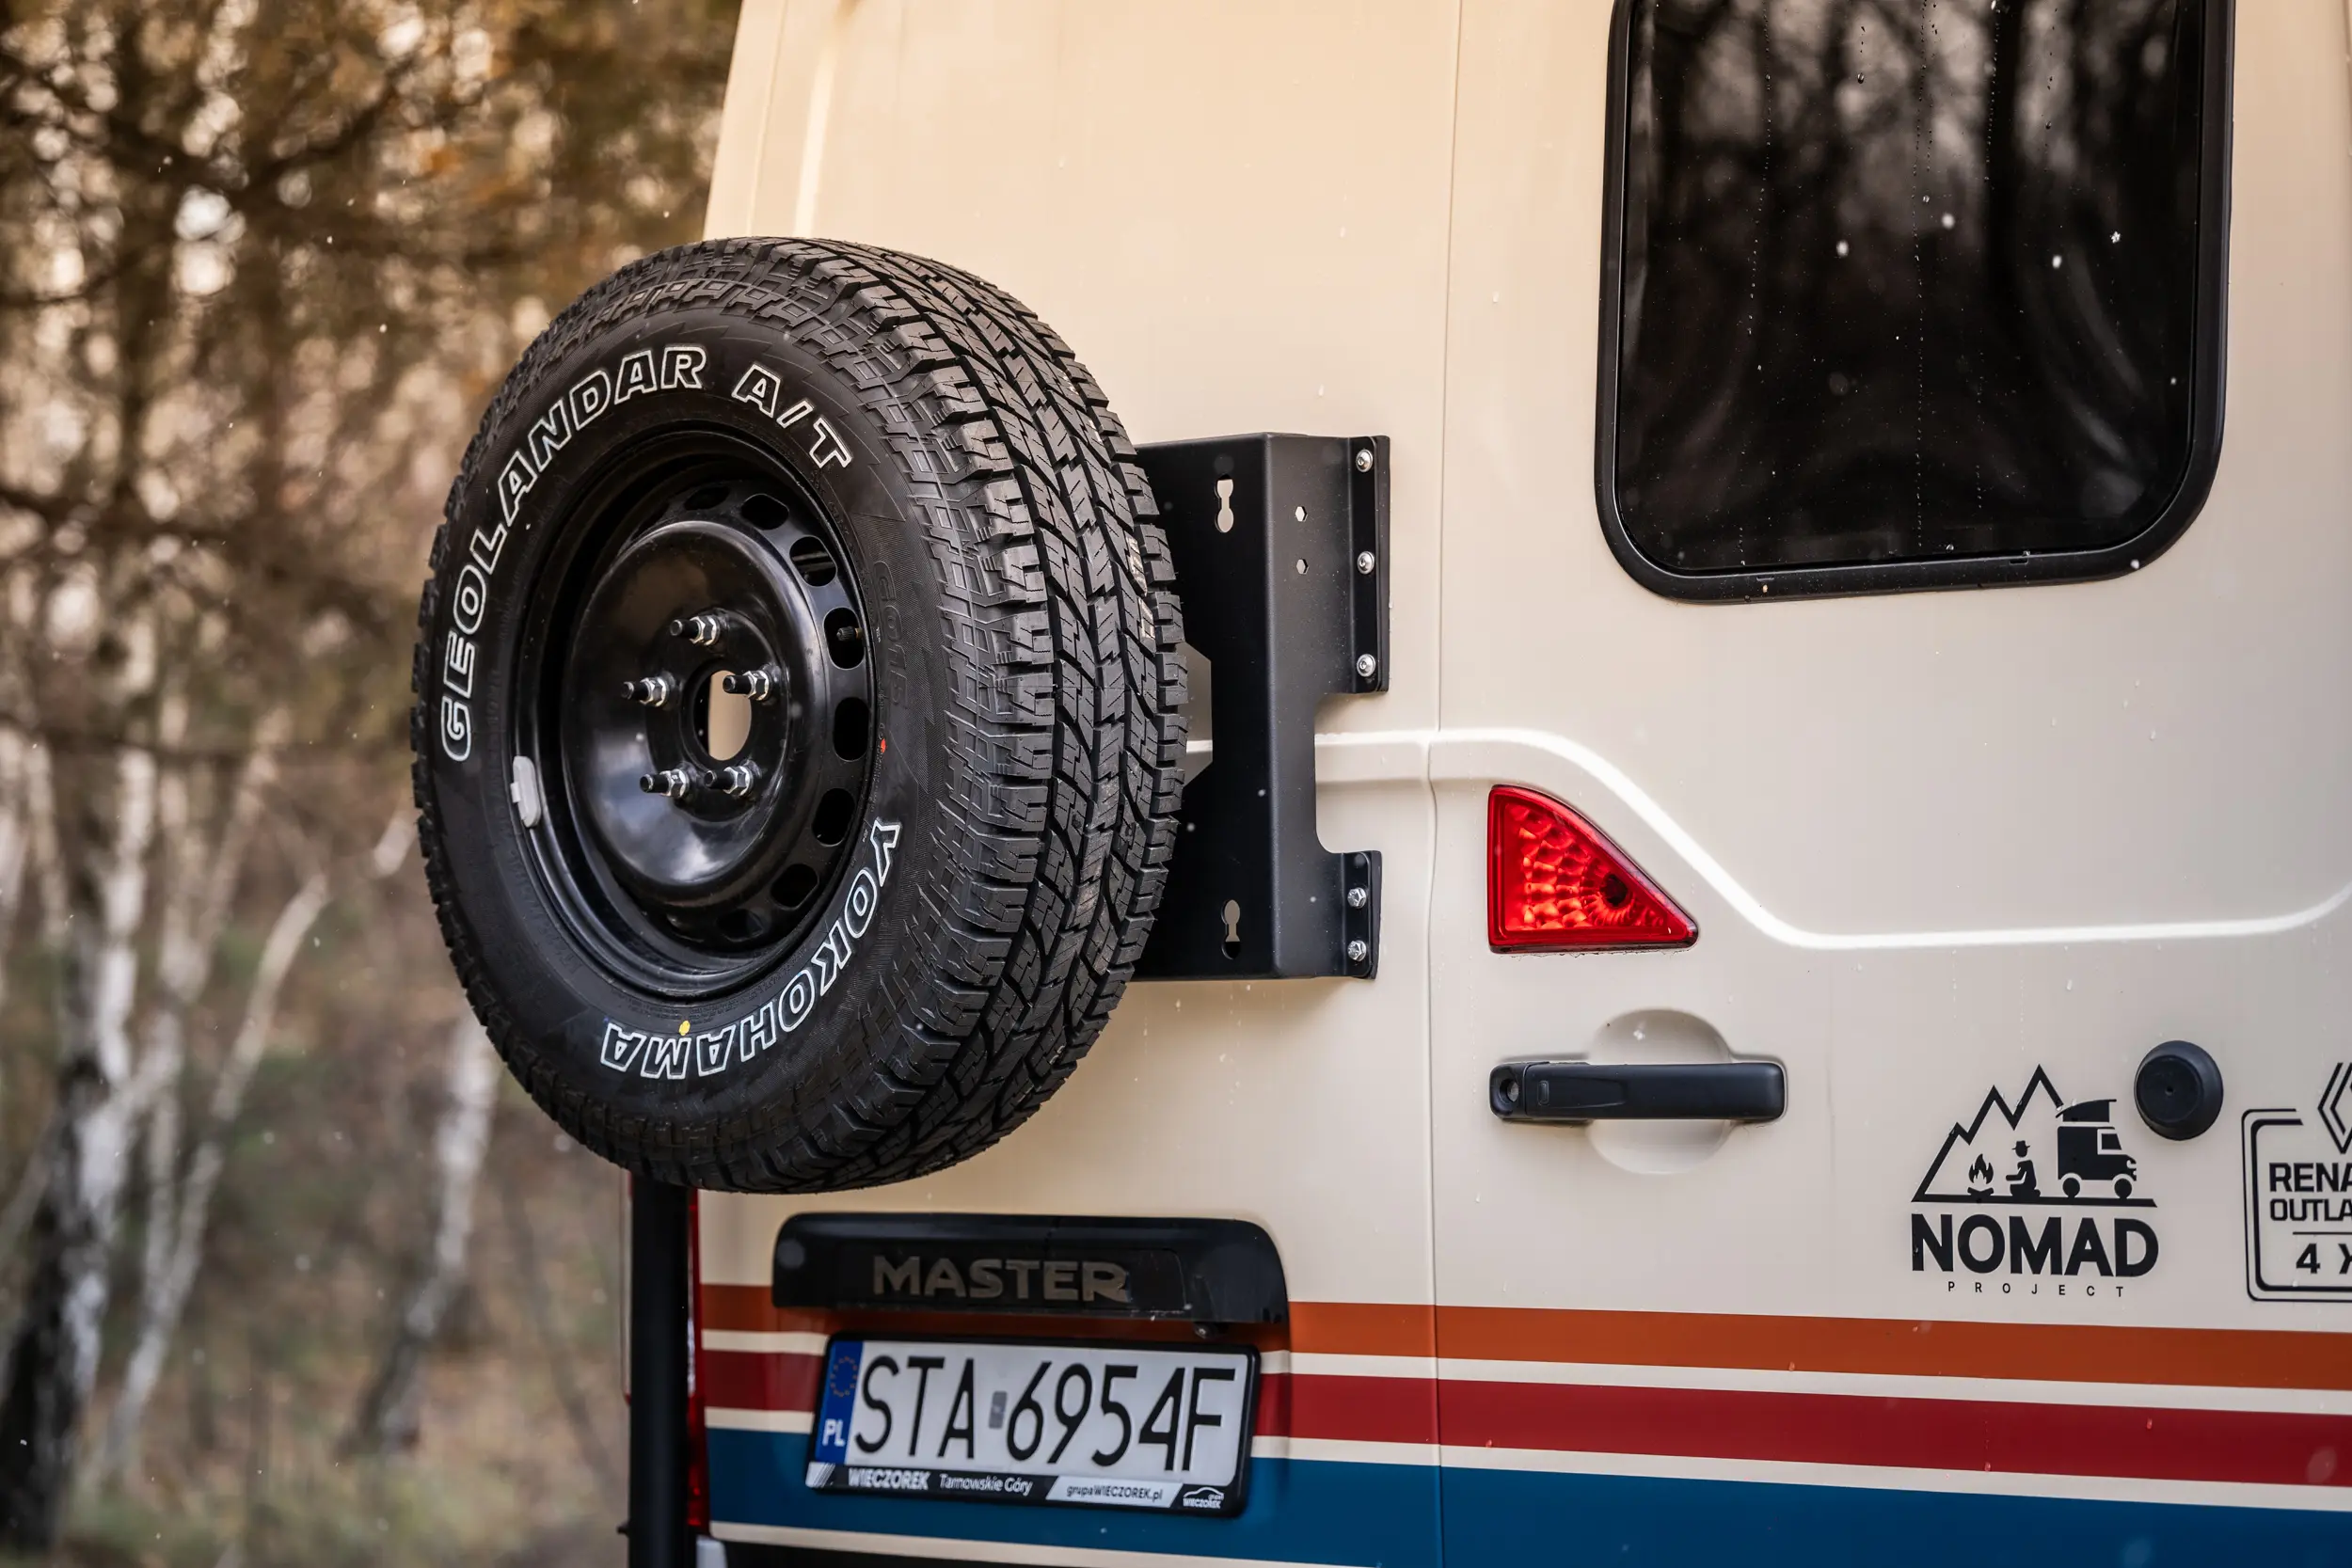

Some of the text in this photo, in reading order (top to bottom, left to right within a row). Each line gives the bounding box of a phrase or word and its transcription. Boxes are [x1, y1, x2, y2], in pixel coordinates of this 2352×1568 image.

[441, 344, 707, 762] GEOLANDAR
[732, 364, 852, 469] A/T
[600, 819, 900, 1080] YOKOHAMA
[1911, 1212, 2159, 1278] NOMAD
[2296, 1243, 2321, 1275] 4
[873, 1256, 1130, 1303] MASTER
[1947, 1281, 2124, 1298] PROJECT
[822, 1418, 845, 1447] PL
[854, 1355, 1235, 1471] STA 6954F
[848, 1467, 1033, 1497] WIECZOREK Tarnowskie Góry
[1066, 1484, 1163, 1502] grupaWIECZOREK.pl
